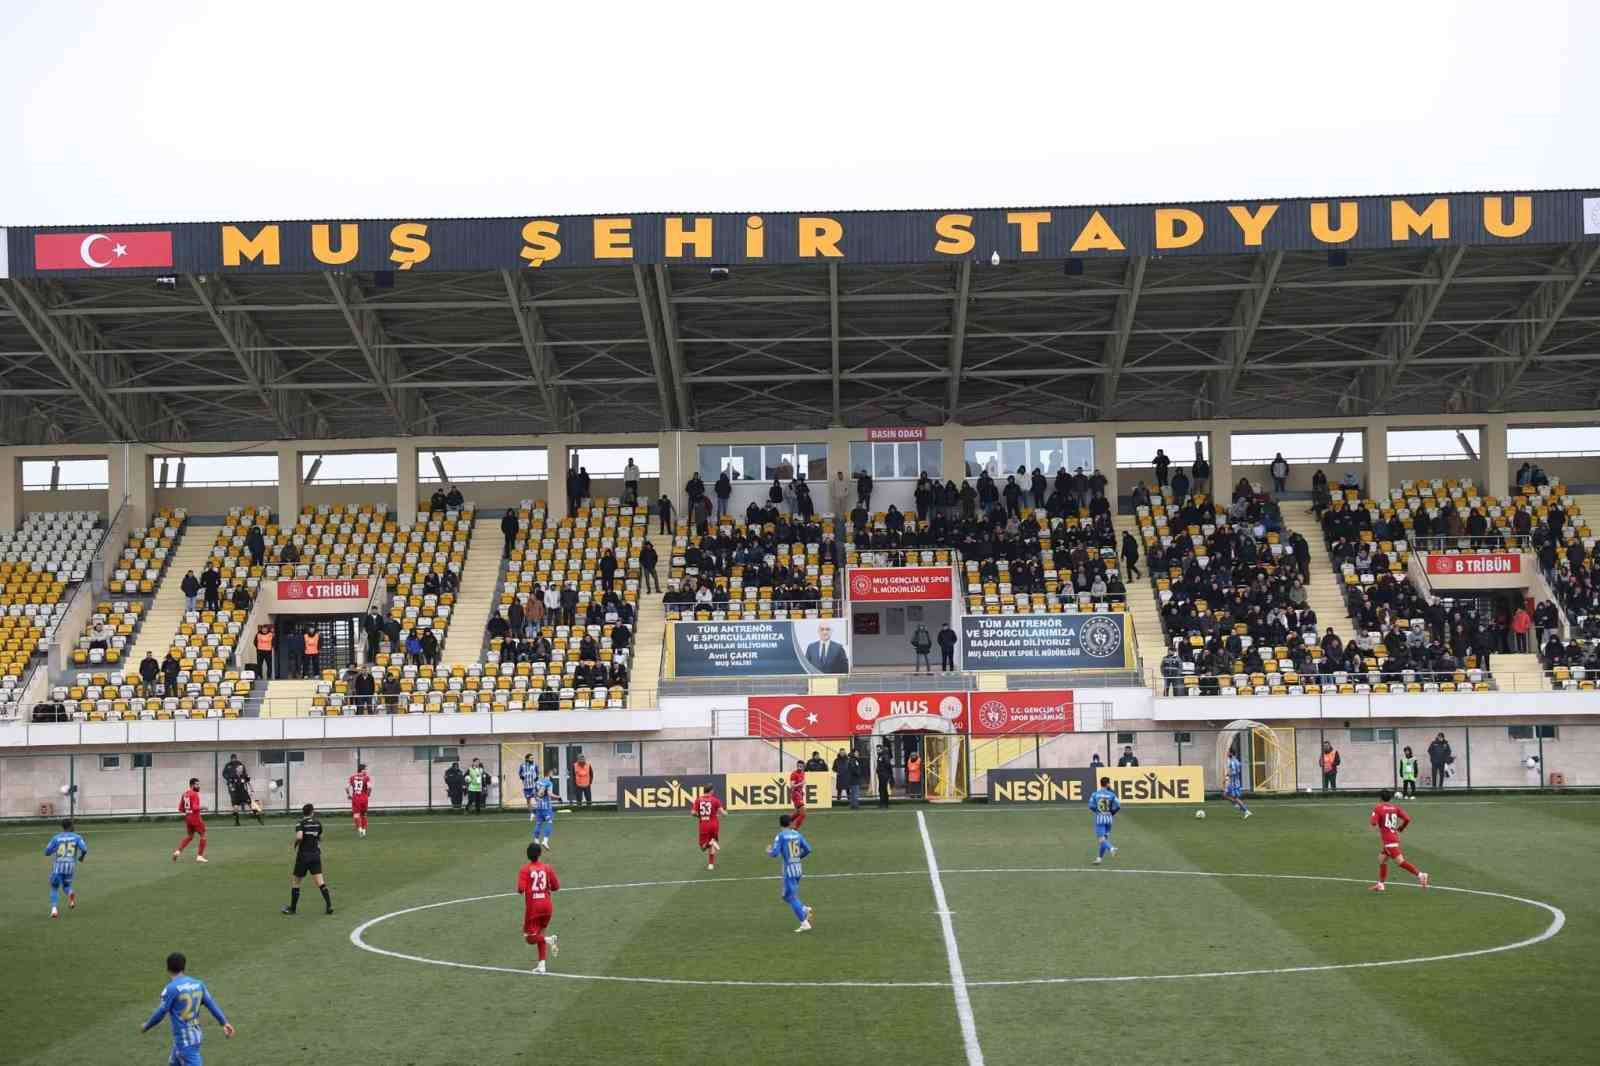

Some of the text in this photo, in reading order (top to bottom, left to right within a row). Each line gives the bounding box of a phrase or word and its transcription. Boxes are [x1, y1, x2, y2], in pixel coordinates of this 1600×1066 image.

[222, 196, 1533, 270] MUŞ ŞEHİR STADYUMU
[871, 429, 897, 439] BASIN
[1455, 557, 1511, 572] B TRİBÜN
[930, 575, 950, 583] SPOR
[306, 582, 359, 598] C TRİBÜN
[979, 618, 1063, 628] TÜM ANTRENÖR
[697, 624, 773, 633] TÜM ANTRENÖR
[966, 628, 1076, 638] VE SPORCULARIMIZA
[686, 633, 785, 642] VE SPORCULARIMIZA
[693, 642, 736, 651] BAŞARILAR
[970, 638, 1071, 648] BAŞARILAR DİLİYORUZ
[708, 651, 758, 661] Avni ÇAKIR
[699, 800, 712, 816] 53
[788, 840, 800, 857] 16
[530, 870, 547, 892] 23
[177, 990, 204, 1020] 27
